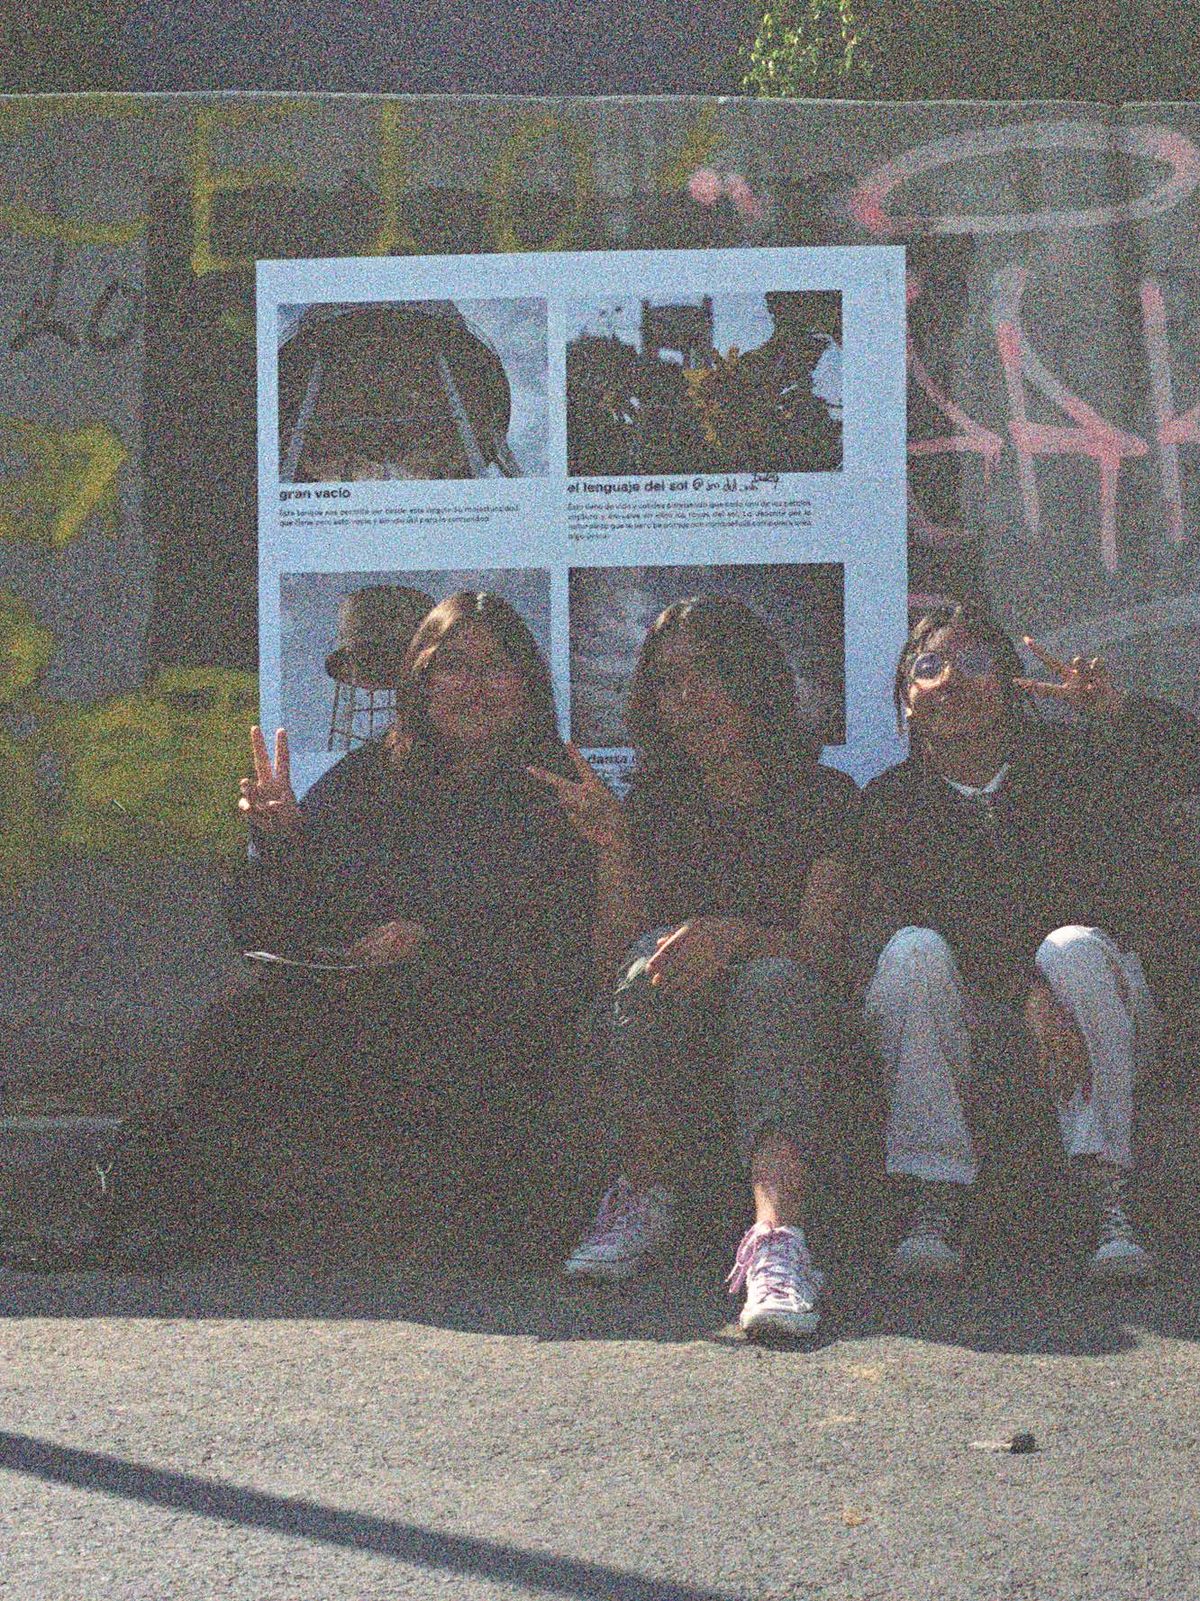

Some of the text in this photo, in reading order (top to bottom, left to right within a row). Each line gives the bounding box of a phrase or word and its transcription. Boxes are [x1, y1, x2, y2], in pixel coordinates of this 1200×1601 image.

[279, 487, 351, 501] gran vacío
[567, 482, 579, 493] el
[583, 481, 640, 494] lenguaje
[644, 480, 665, 492] del
[669, 480, 688, 491] sol
